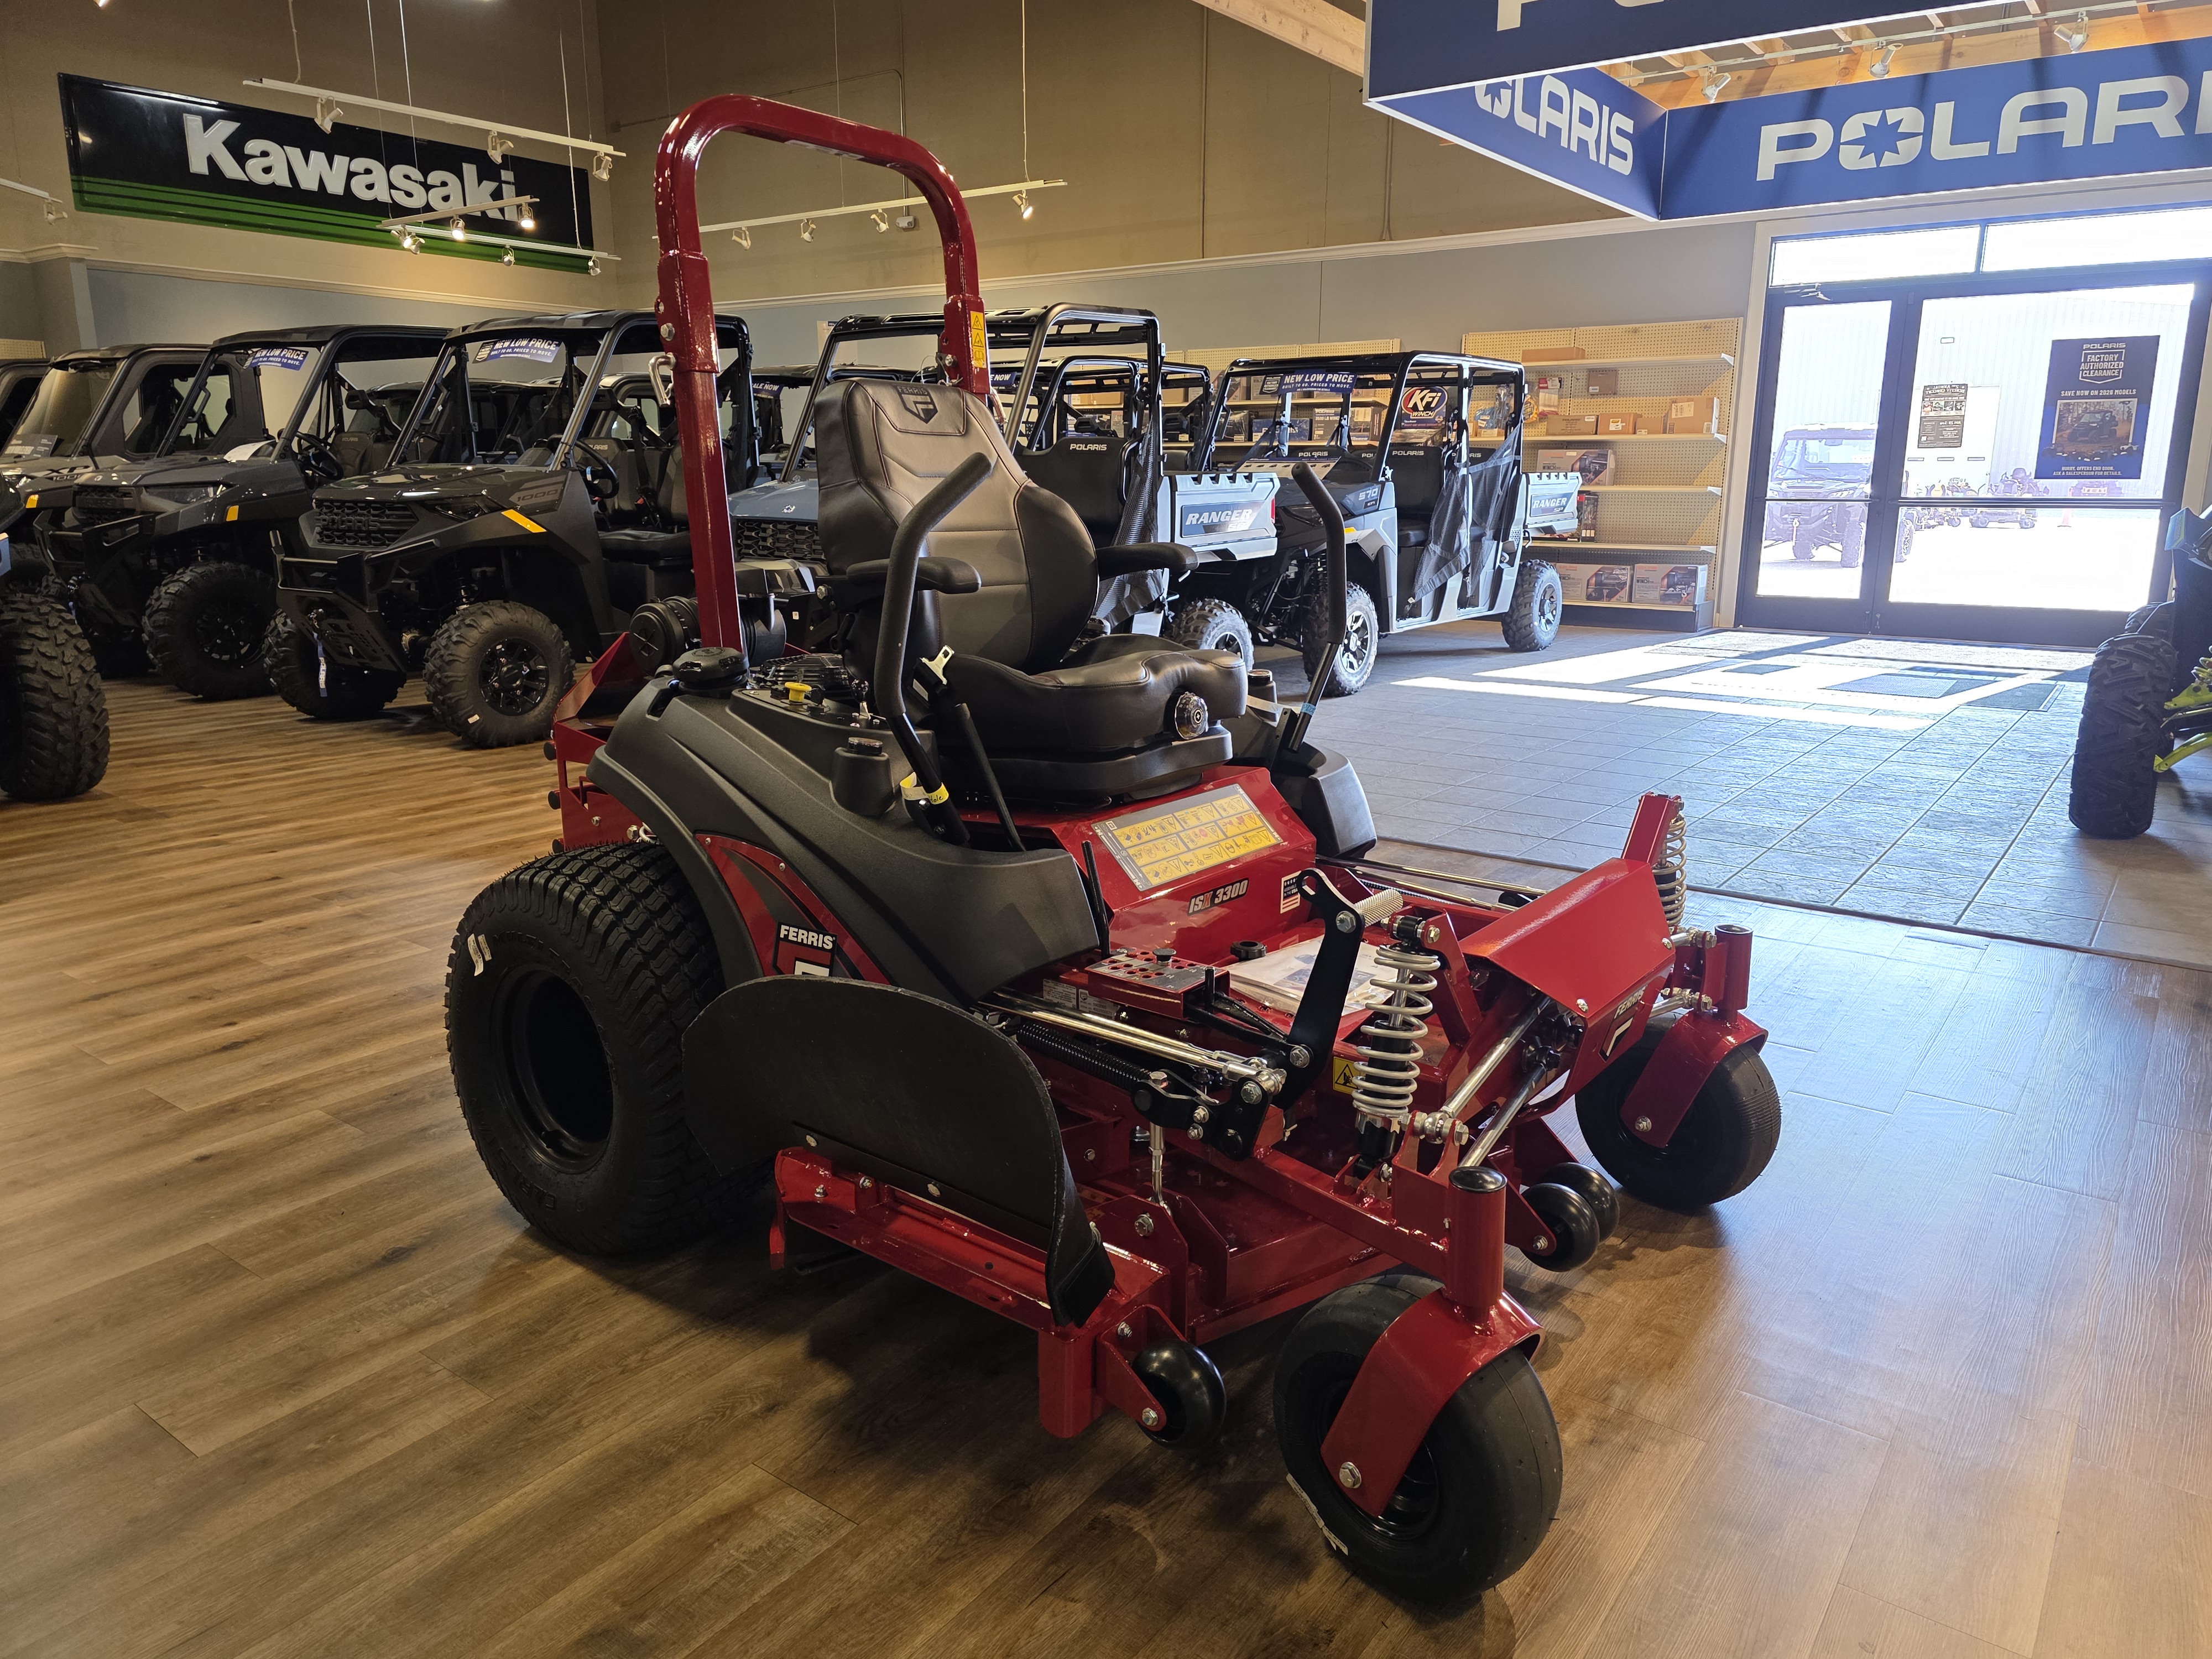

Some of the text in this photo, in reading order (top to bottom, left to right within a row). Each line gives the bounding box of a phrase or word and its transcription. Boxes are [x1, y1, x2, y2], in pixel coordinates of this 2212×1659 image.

[1475, 75, 1634, 176] OLARIS
[1756, 69, 2212, 181] POLARI
[183, 112, 519, 222] Kawasaki
[494, 338, 559, 351] NEW LOW PRICE
[267, 348, 283, 357] LOW
[281, 349, 306, 360] PRICE
[2087, 354, 2119, 362] FACTORY
[2080, 362, 2124, 370] AUTHORIZED
[1284, 373, 1355, 384] NEW LOW PRICE
[1407, 389, 1442, 411] KFi
[43, 465, 91, 477] XP
[517, 489, 558, 502] 1000
[1358, 488, 1378, 500] 570
[1532, 498, 1567, 509] RANGER
[1185, 509, 1253, 525] RANGER
[1188, 879, 1249, 914] ISX 3300
[780, 925, 833, 950] FERRIS
[1614, 986, 1646, 1019] FERRIS
